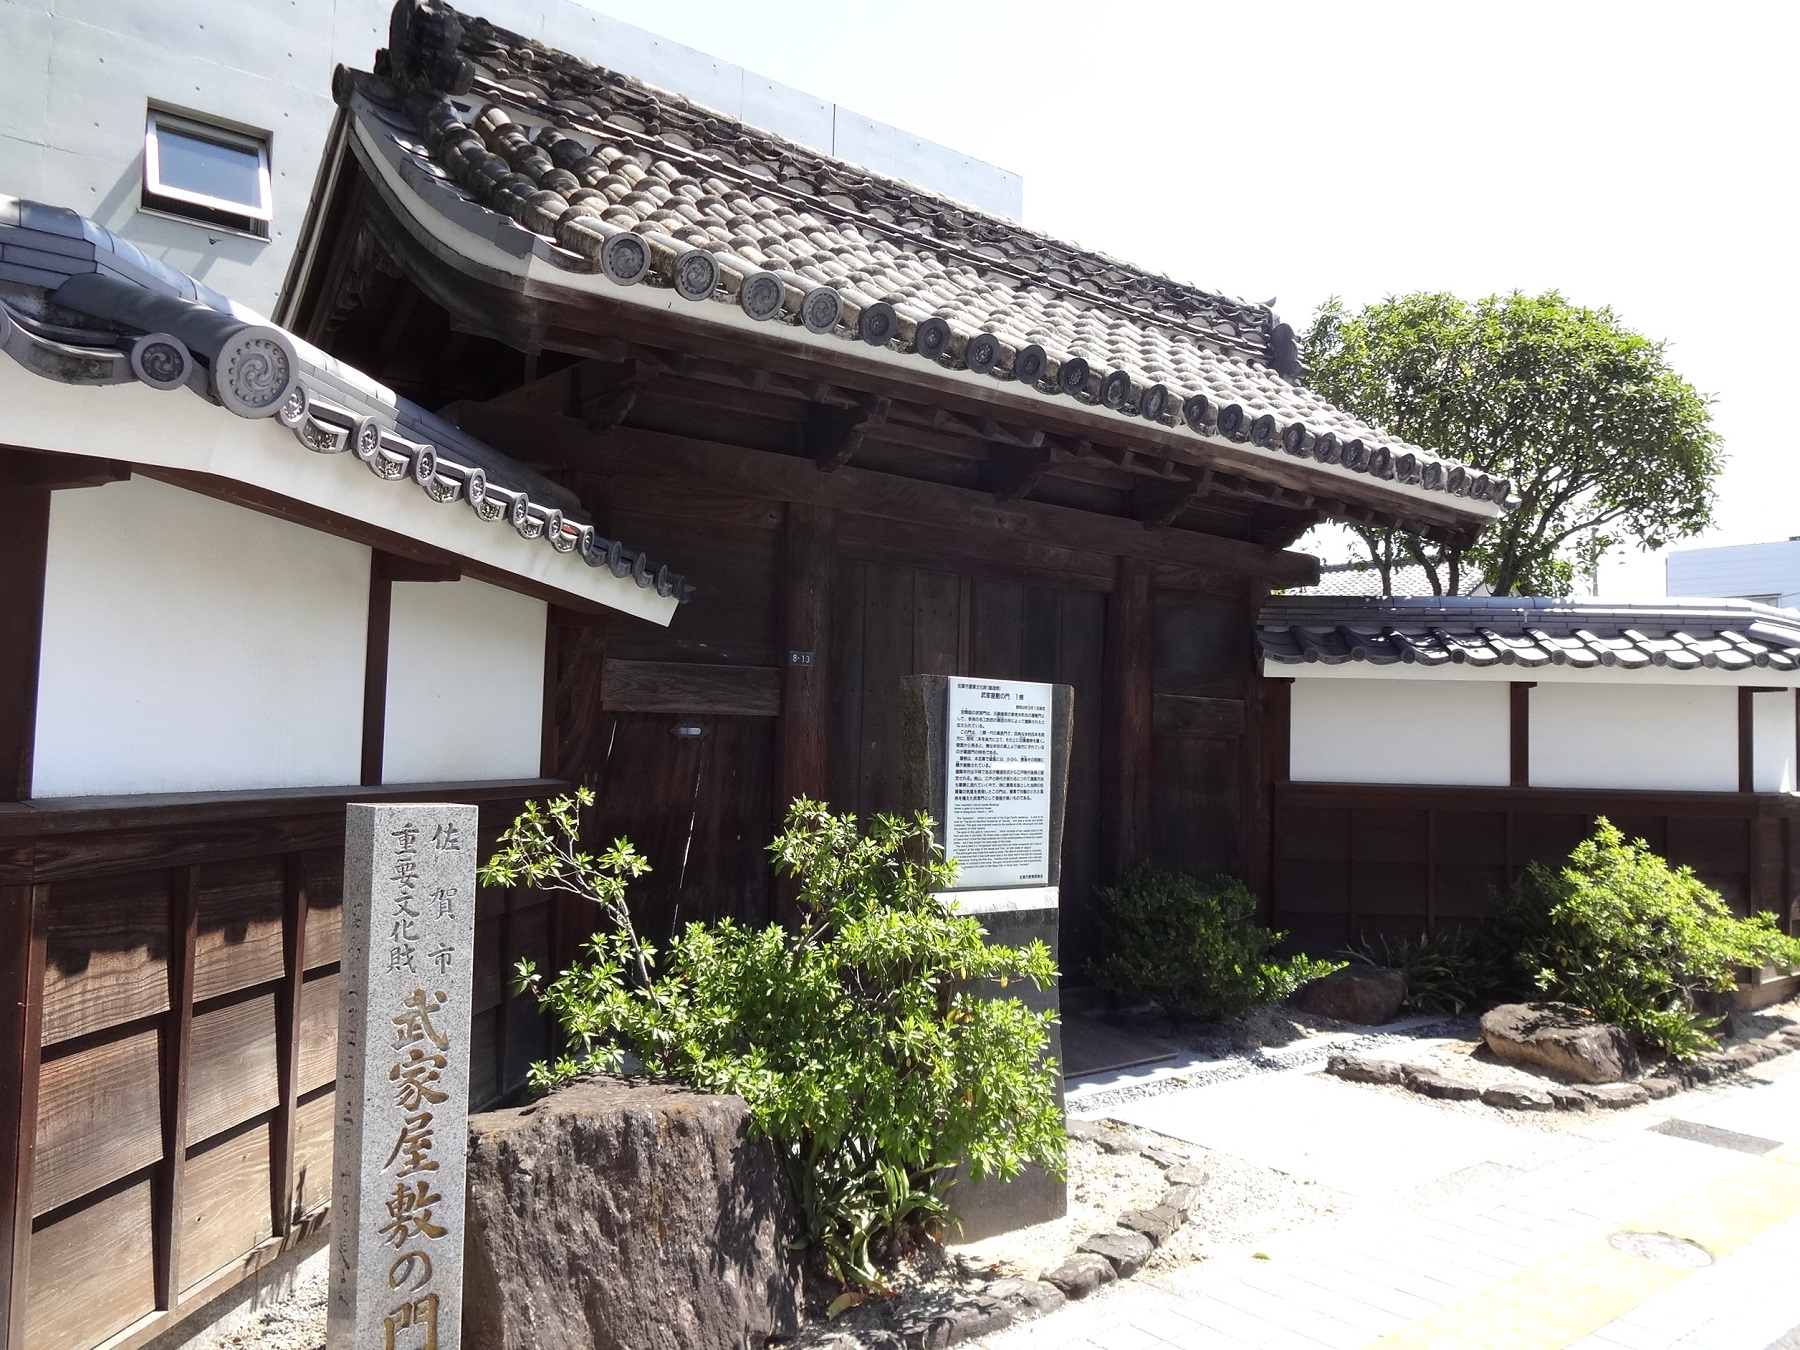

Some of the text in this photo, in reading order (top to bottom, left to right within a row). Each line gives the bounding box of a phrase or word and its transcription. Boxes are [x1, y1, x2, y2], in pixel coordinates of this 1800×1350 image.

[980, 691, 1010, 700] 武家屋敷の門
[386, 822, 421, 975] 重要文化財
[378, 988, 449, 1350] 武家屋敷の門
